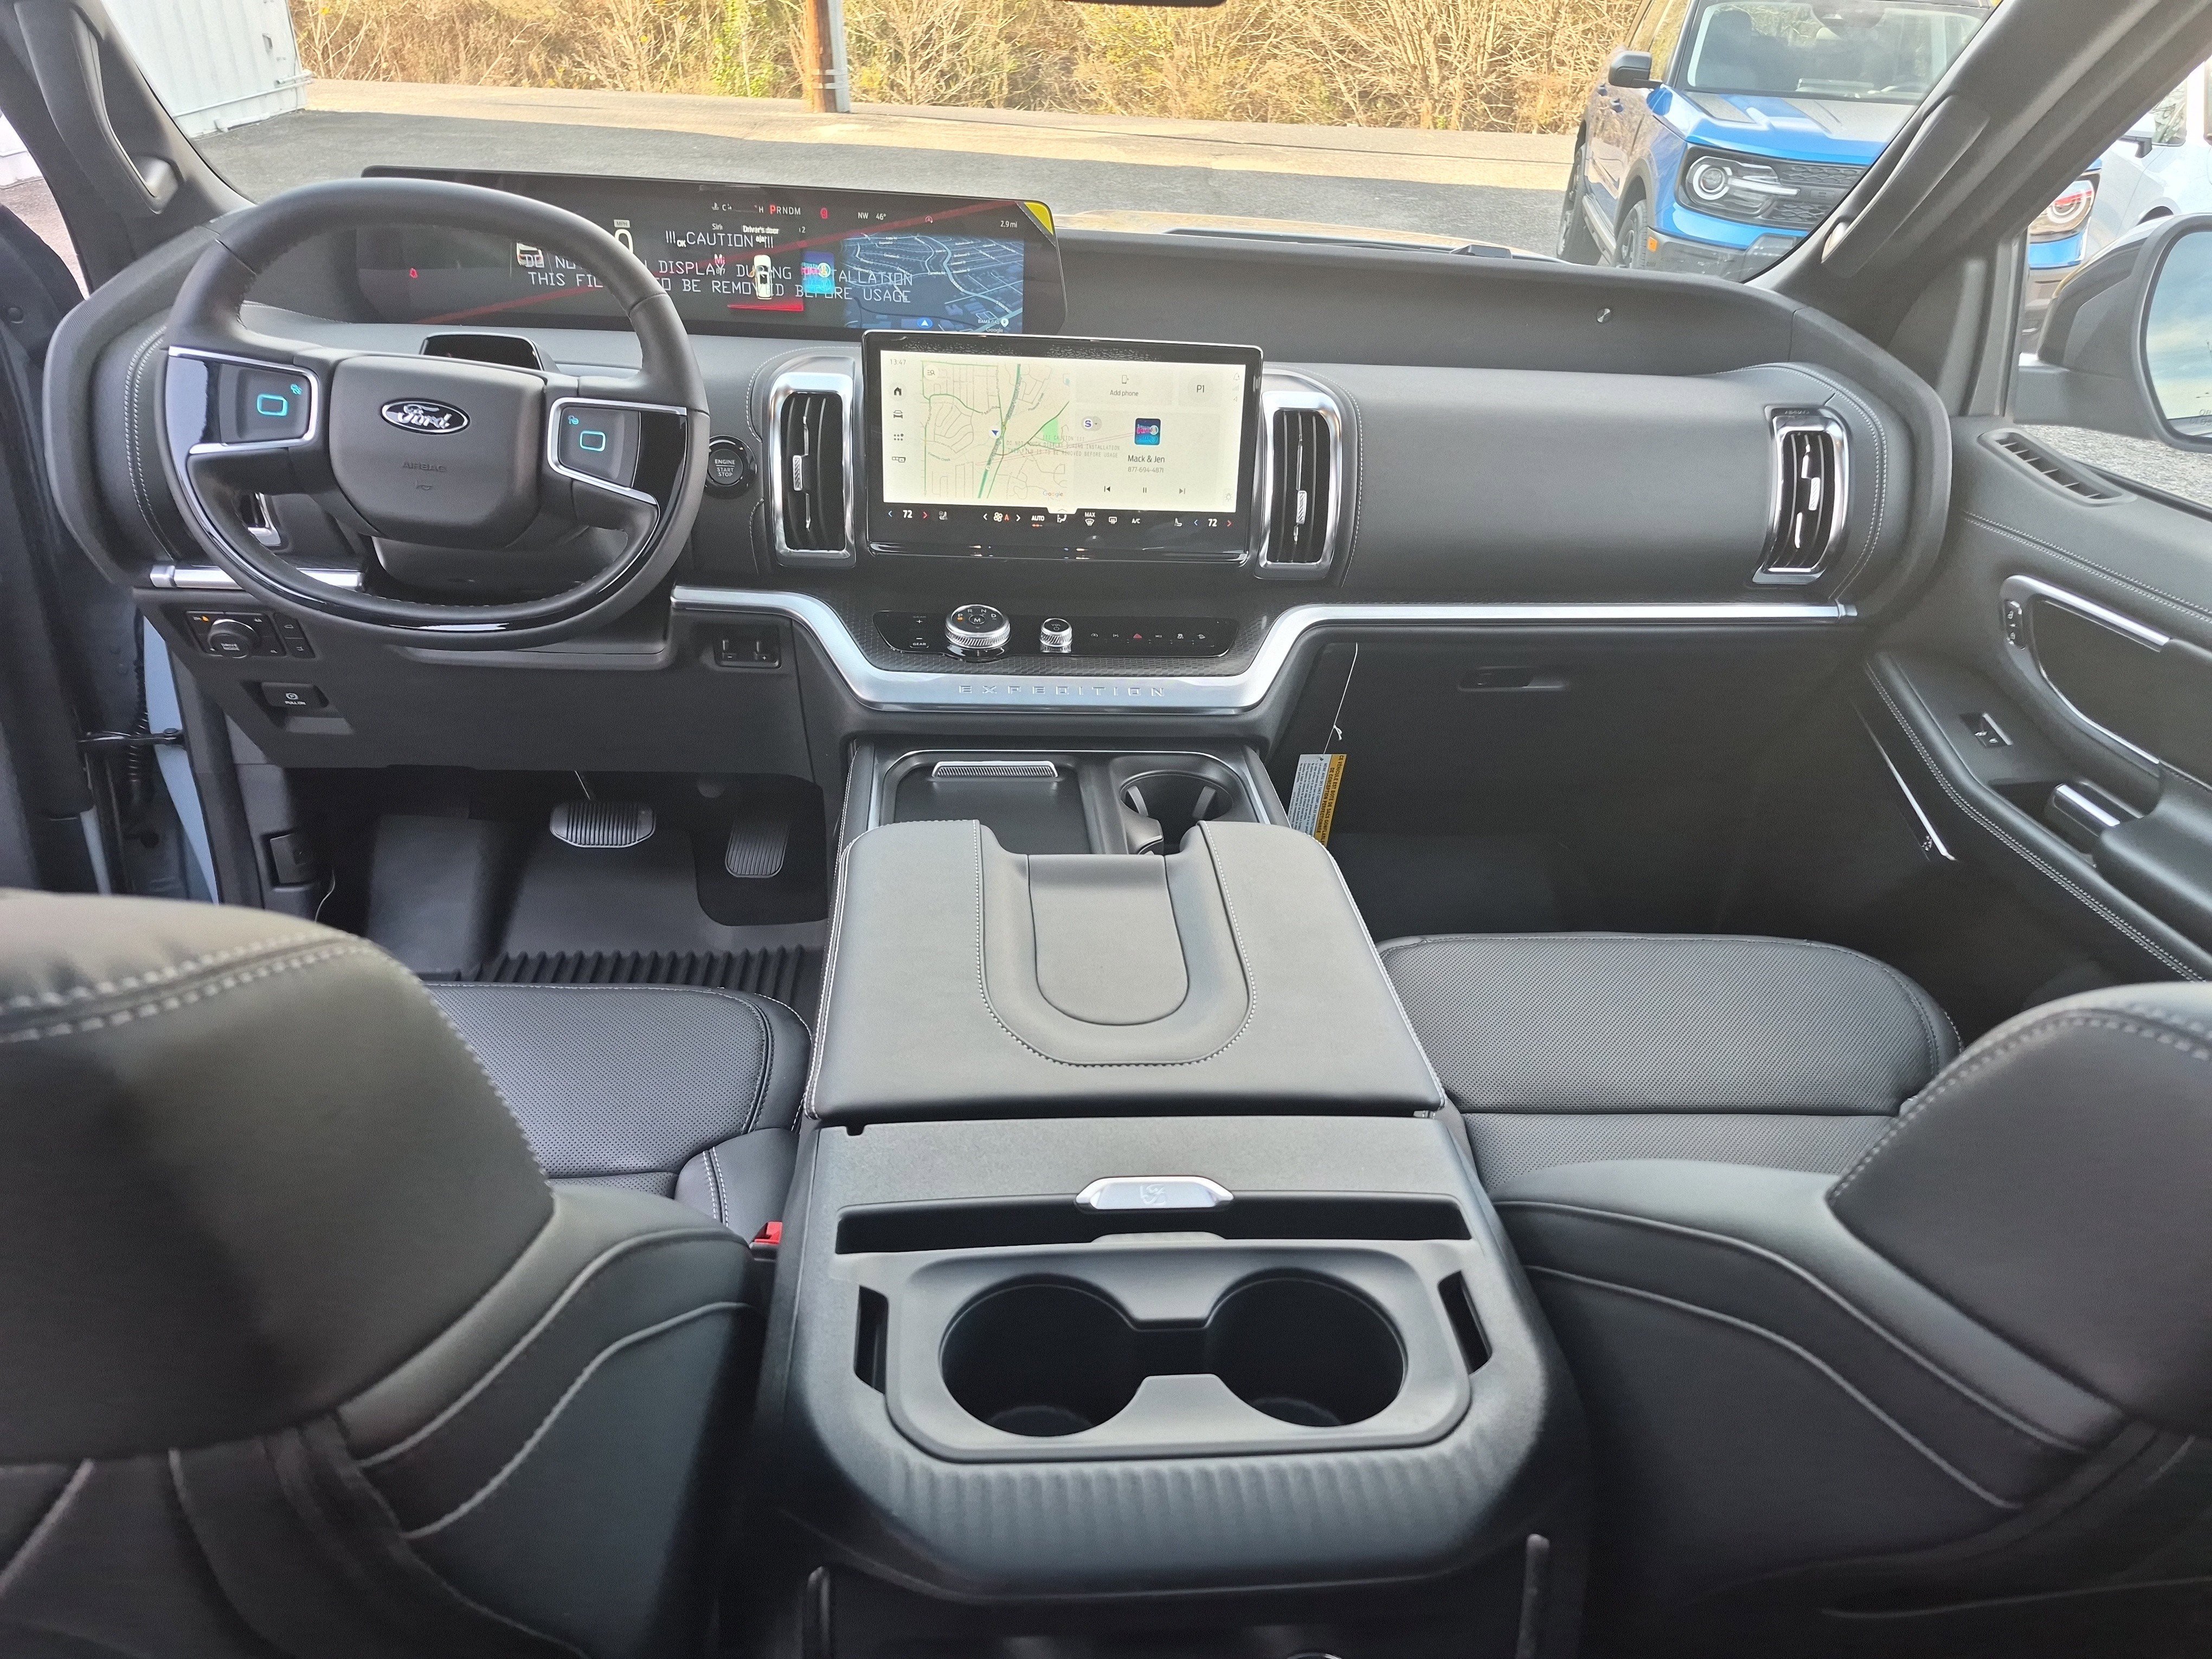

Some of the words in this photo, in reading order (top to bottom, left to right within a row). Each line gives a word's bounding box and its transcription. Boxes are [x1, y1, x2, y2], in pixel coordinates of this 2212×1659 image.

[686, 232, 754, 248] CAUTION
[658, 260, 725, 276] DISPLAY
[528, 271, 565, 286] THIS
[576, 274, 604, 288] FIL
[682, 279, 702, 293] BE
[863, 288, 911, 303] USAGE
[1197, 385, 1205, 393] P1
[903, 510, 912, 518] 72
[1208, 518, 1218, 527] 72
[959, 685, 1165, 697] EXPEDITION
